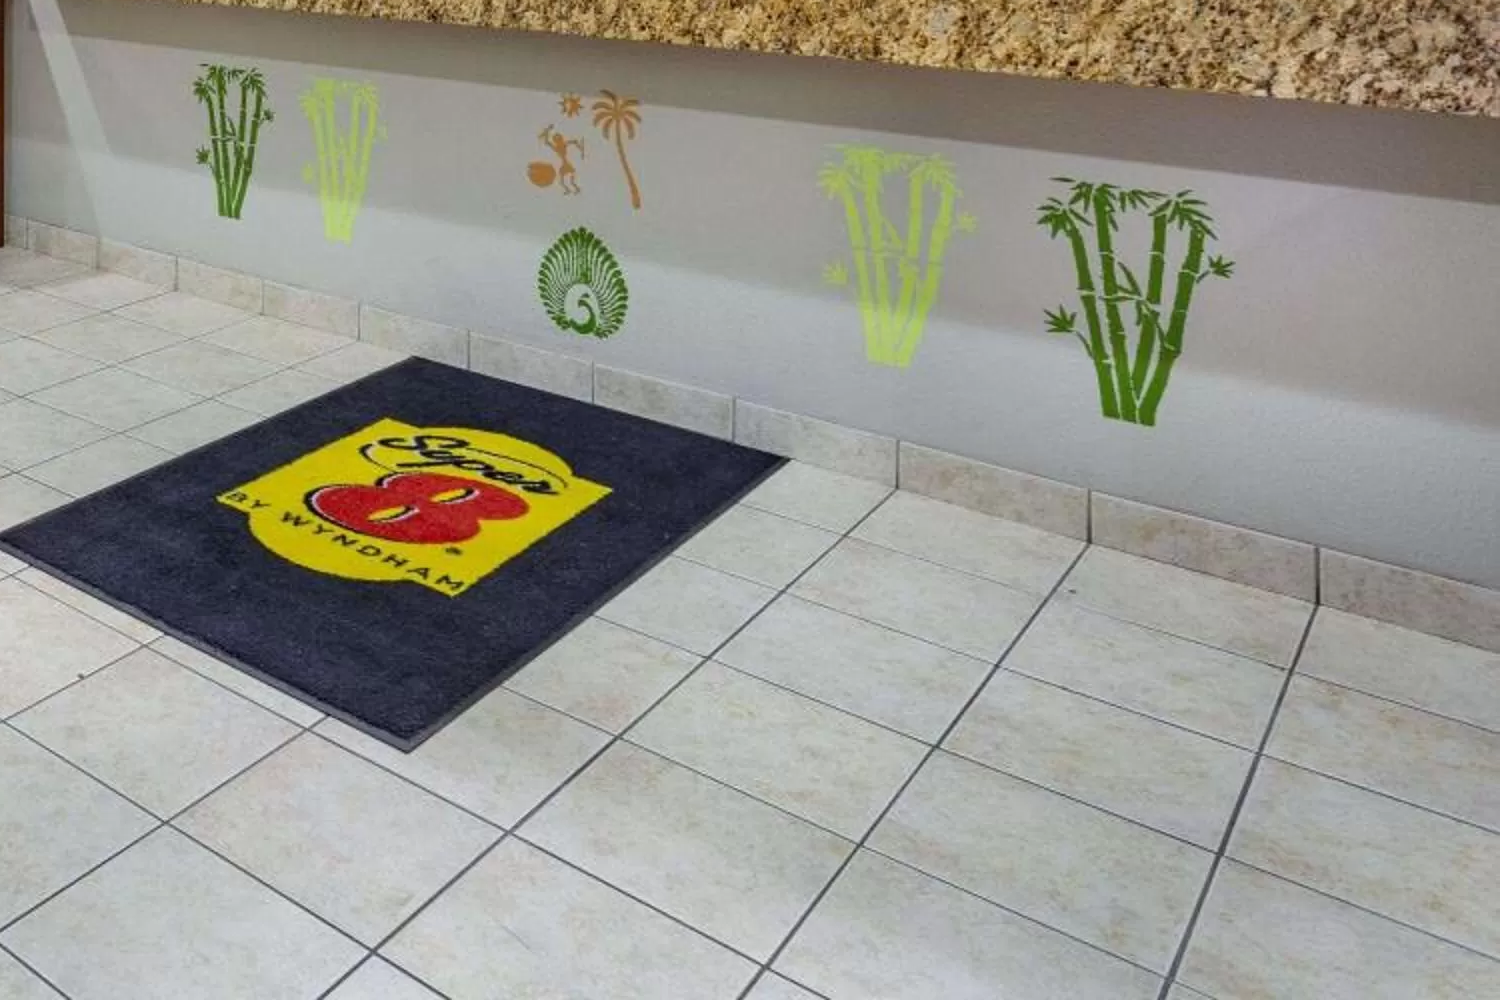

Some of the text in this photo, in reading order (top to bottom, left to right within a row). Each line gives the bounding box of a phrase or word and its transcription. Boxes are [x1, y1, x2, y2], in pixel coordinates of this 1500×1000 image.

[376, 434, 560, 496] Super
[225, 490, 465, 592] BY WYNDHAM
[303, 471, 531, 545] 8
